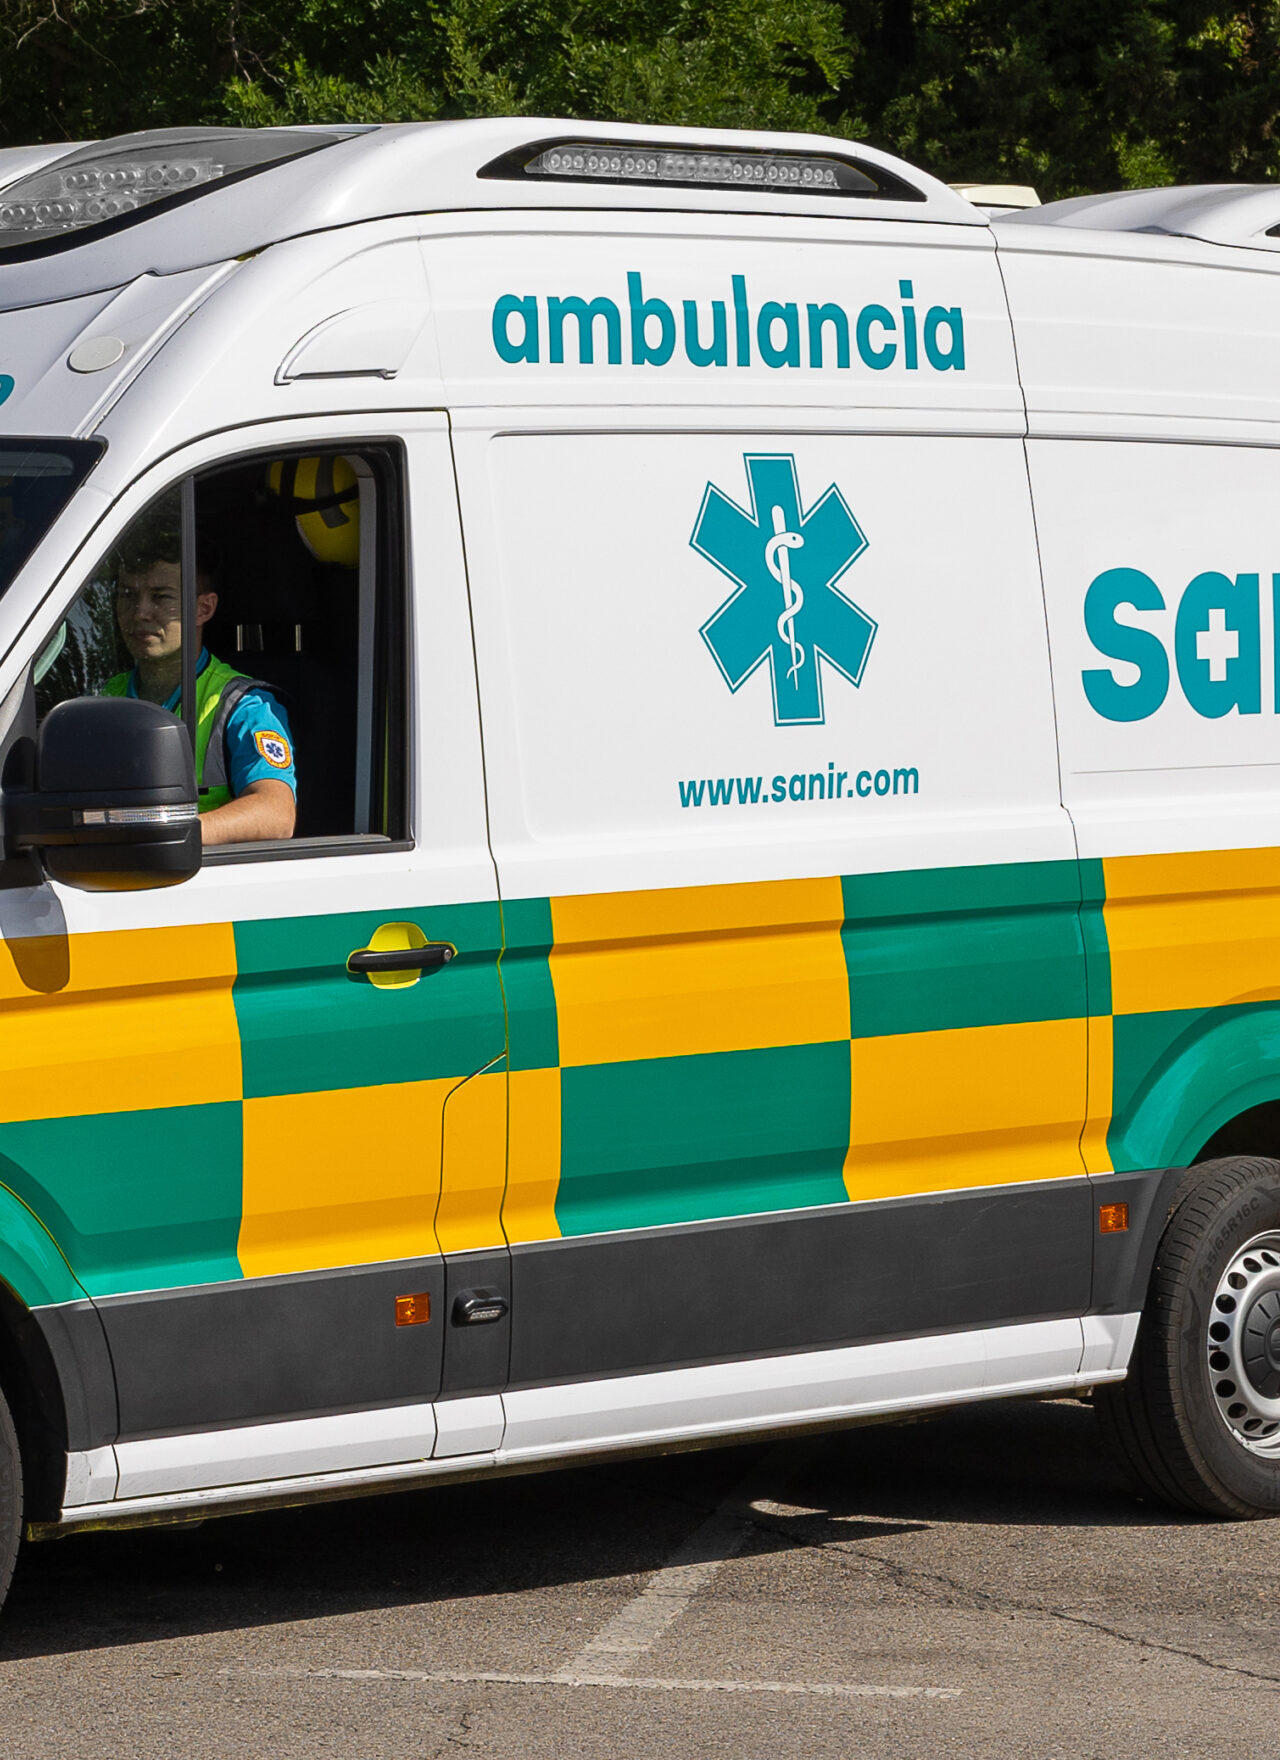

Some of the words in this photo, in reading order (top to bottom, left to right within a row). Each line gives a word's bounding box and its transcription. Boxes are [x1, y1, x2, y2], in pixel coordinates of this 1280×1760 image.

[492, 272, 965, 371] ambulancia
[1081, 567, 1280, 722] sa
[678, 762, 919, 808] www.sanir.com
